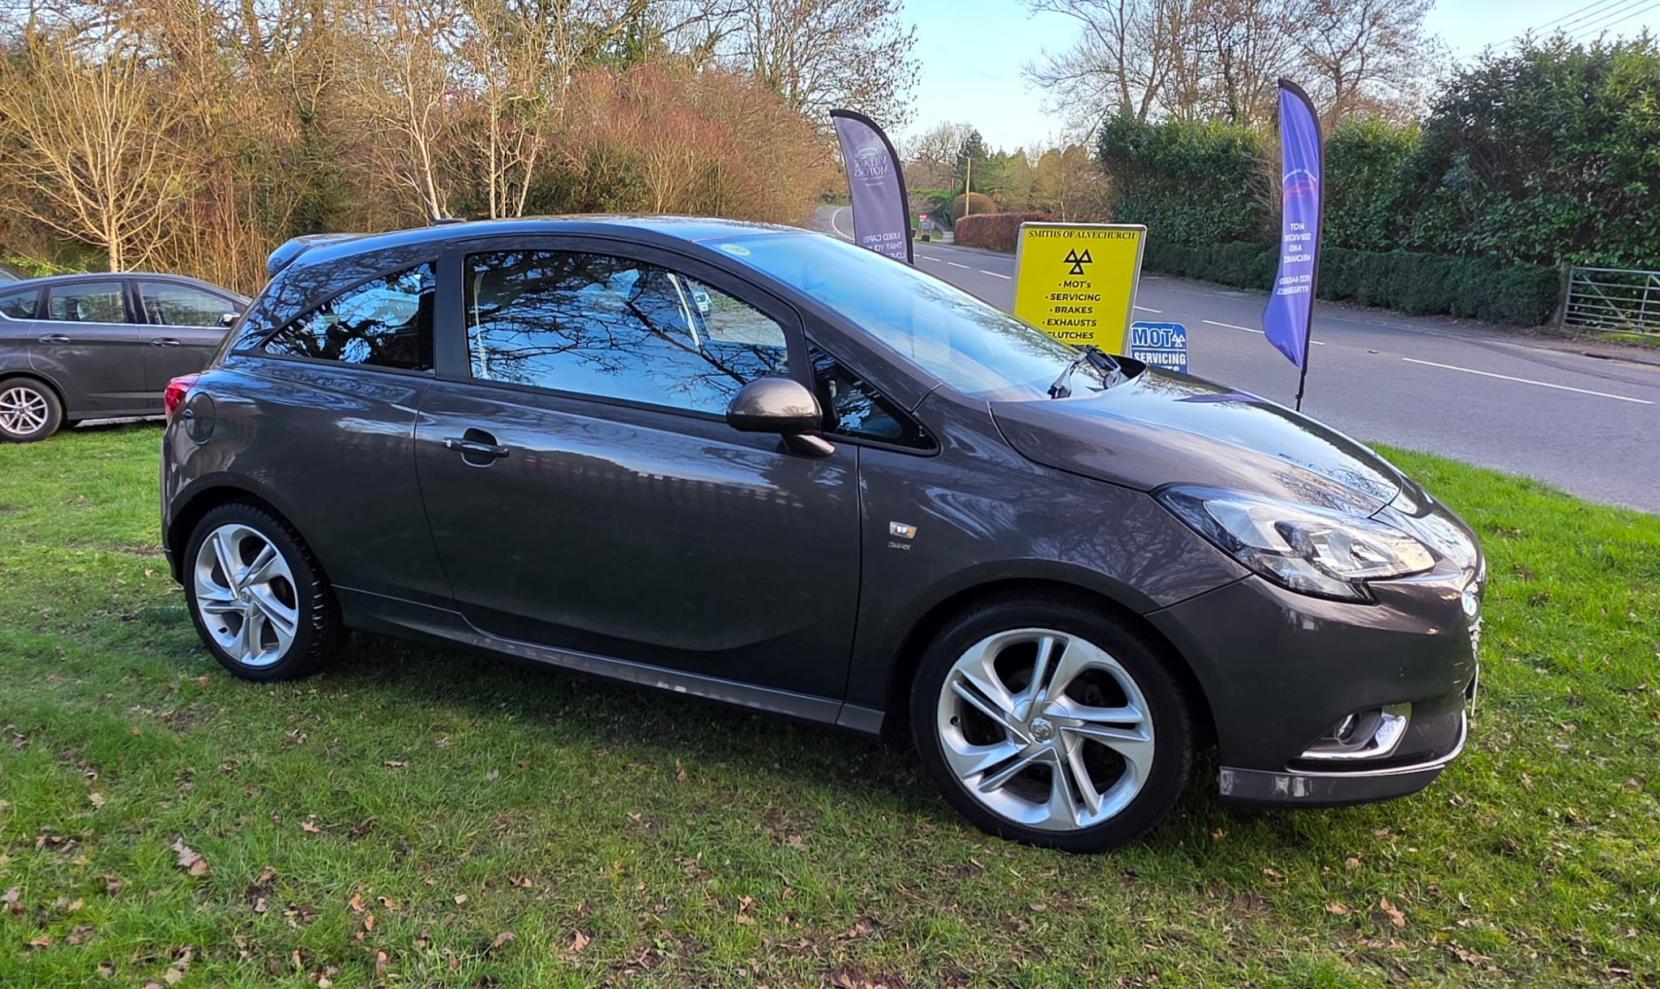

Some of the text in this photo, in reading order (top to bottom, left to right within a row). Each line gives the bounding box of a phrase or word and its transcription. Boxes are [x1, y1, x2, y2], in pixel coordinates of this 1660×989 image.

[1028, 230, 1136, 240] SMITHS OF ALVECHURCH
[1063, 280, 1092, 289] MOT's
[1050, 293, 1101, 302] SERVICING
[1054, 306, 1094, 314] BRAKES
[1047, 318, 1097, 327] EXHAUSTS
[1132, 328, 1174, 347] MOT
[1134, 351, 1187, 366] SERVICING
